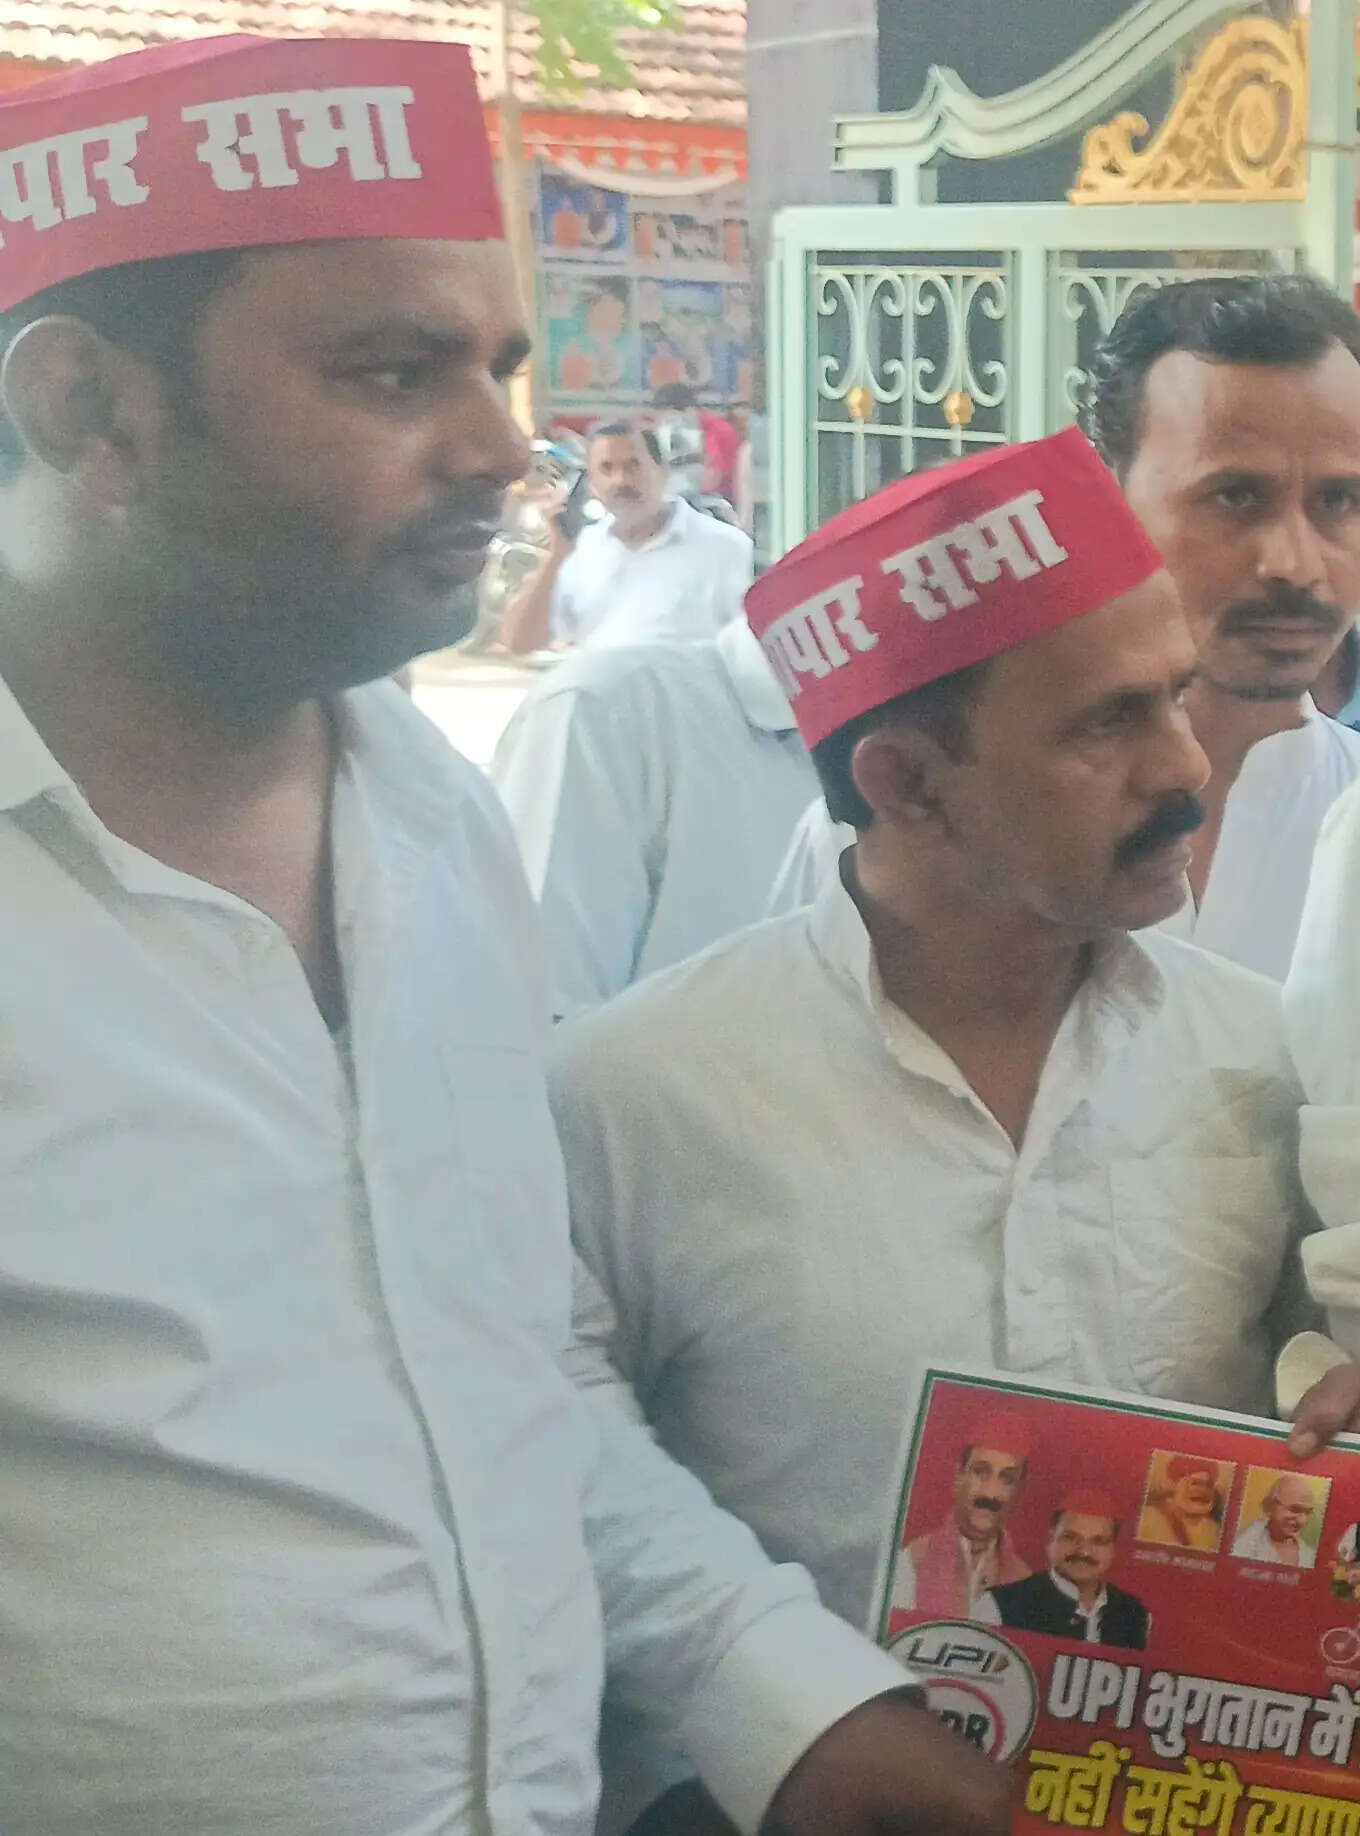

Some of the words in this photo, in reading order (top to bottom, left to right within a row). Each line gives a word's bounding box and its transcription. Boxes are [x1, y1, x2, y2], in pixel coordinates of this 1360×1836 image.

[181, 86, 423, 191] सभा
[880, 489, 1069, 621] सभा
[908, 1637, 992, 1673] UPI
[1047, 1654, 1141, 1729] UPI
[1144, 1671, 1312, 1758] भुगतान
[1025, 1741, 1131, 1828] नहीं
[1123, 1755, 1244, 1836] सहेंगे
